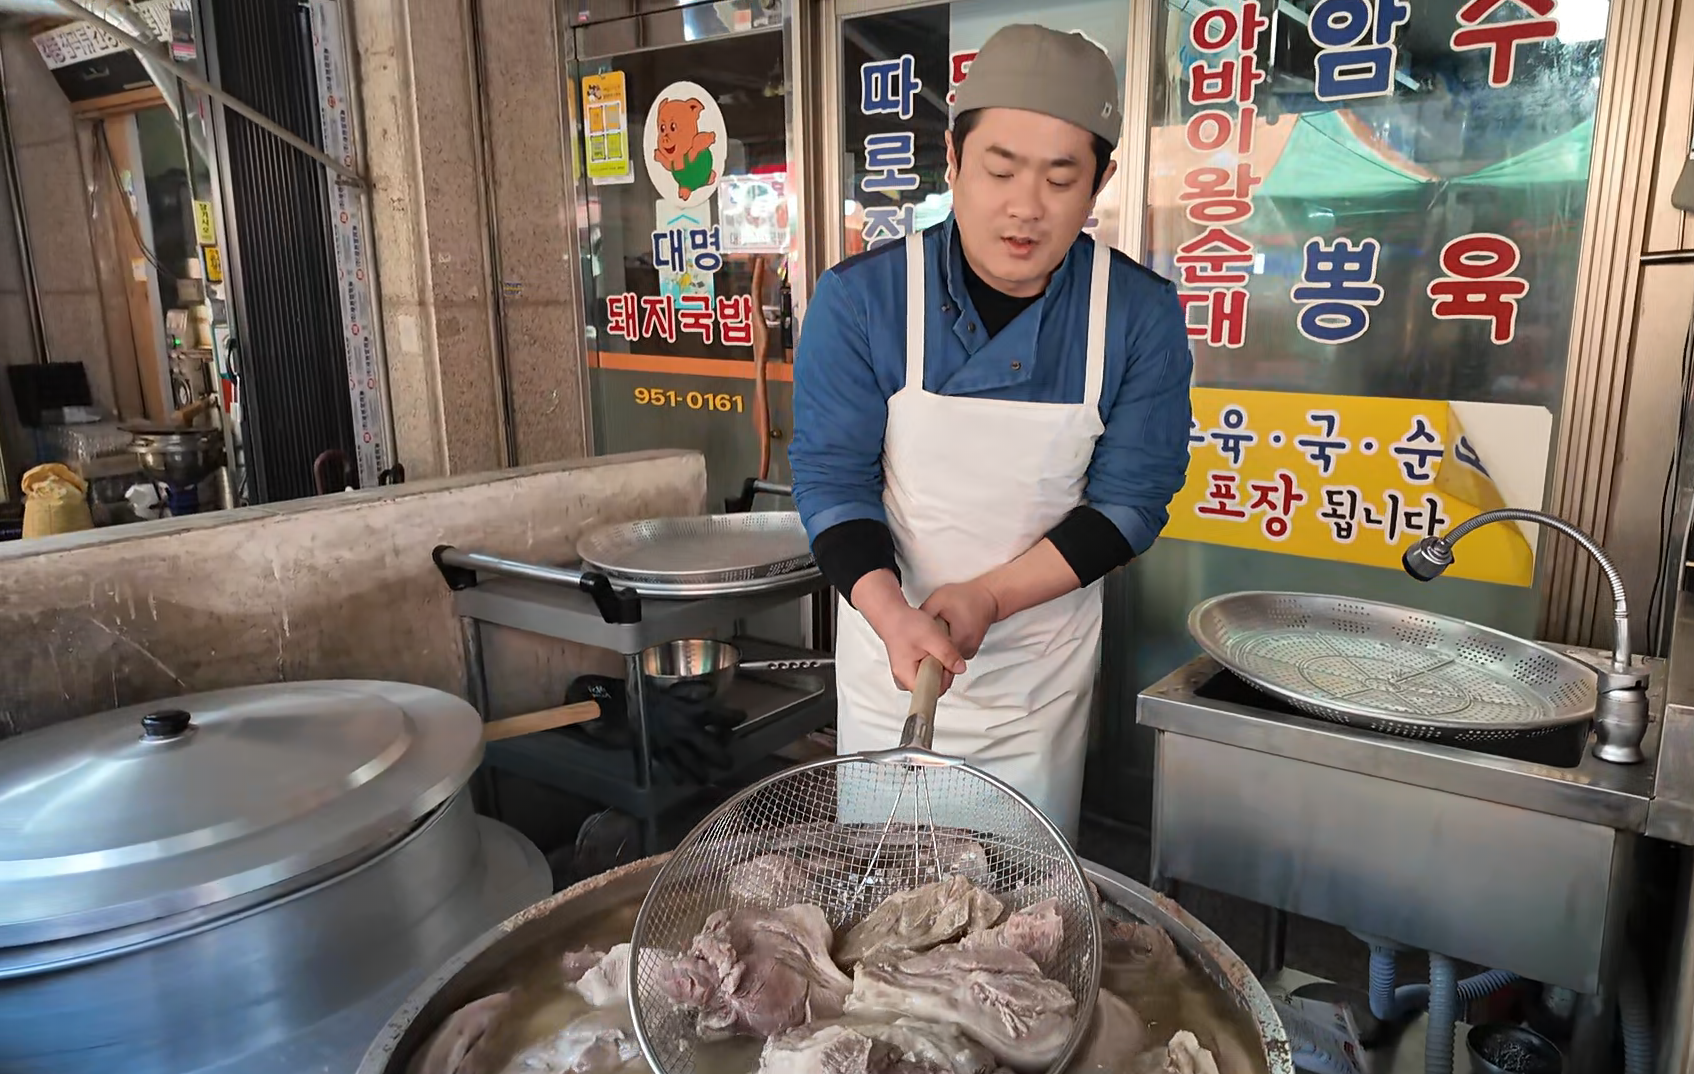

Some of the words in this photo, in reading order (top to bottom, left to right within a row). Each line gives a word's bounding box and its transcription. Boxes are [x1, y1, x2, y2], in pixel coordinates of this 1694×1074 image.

[1174, 2, 1270, 347] 아바이왕순대
[652, 225, 723, 273] 대명
[606, 293, 754, 346] 돼지국밥
[633, 386, 744, 414] 951-0161
[1197, 473, 1304, 538] 포장
[1320, 488, 1447, 541] 됩니다
